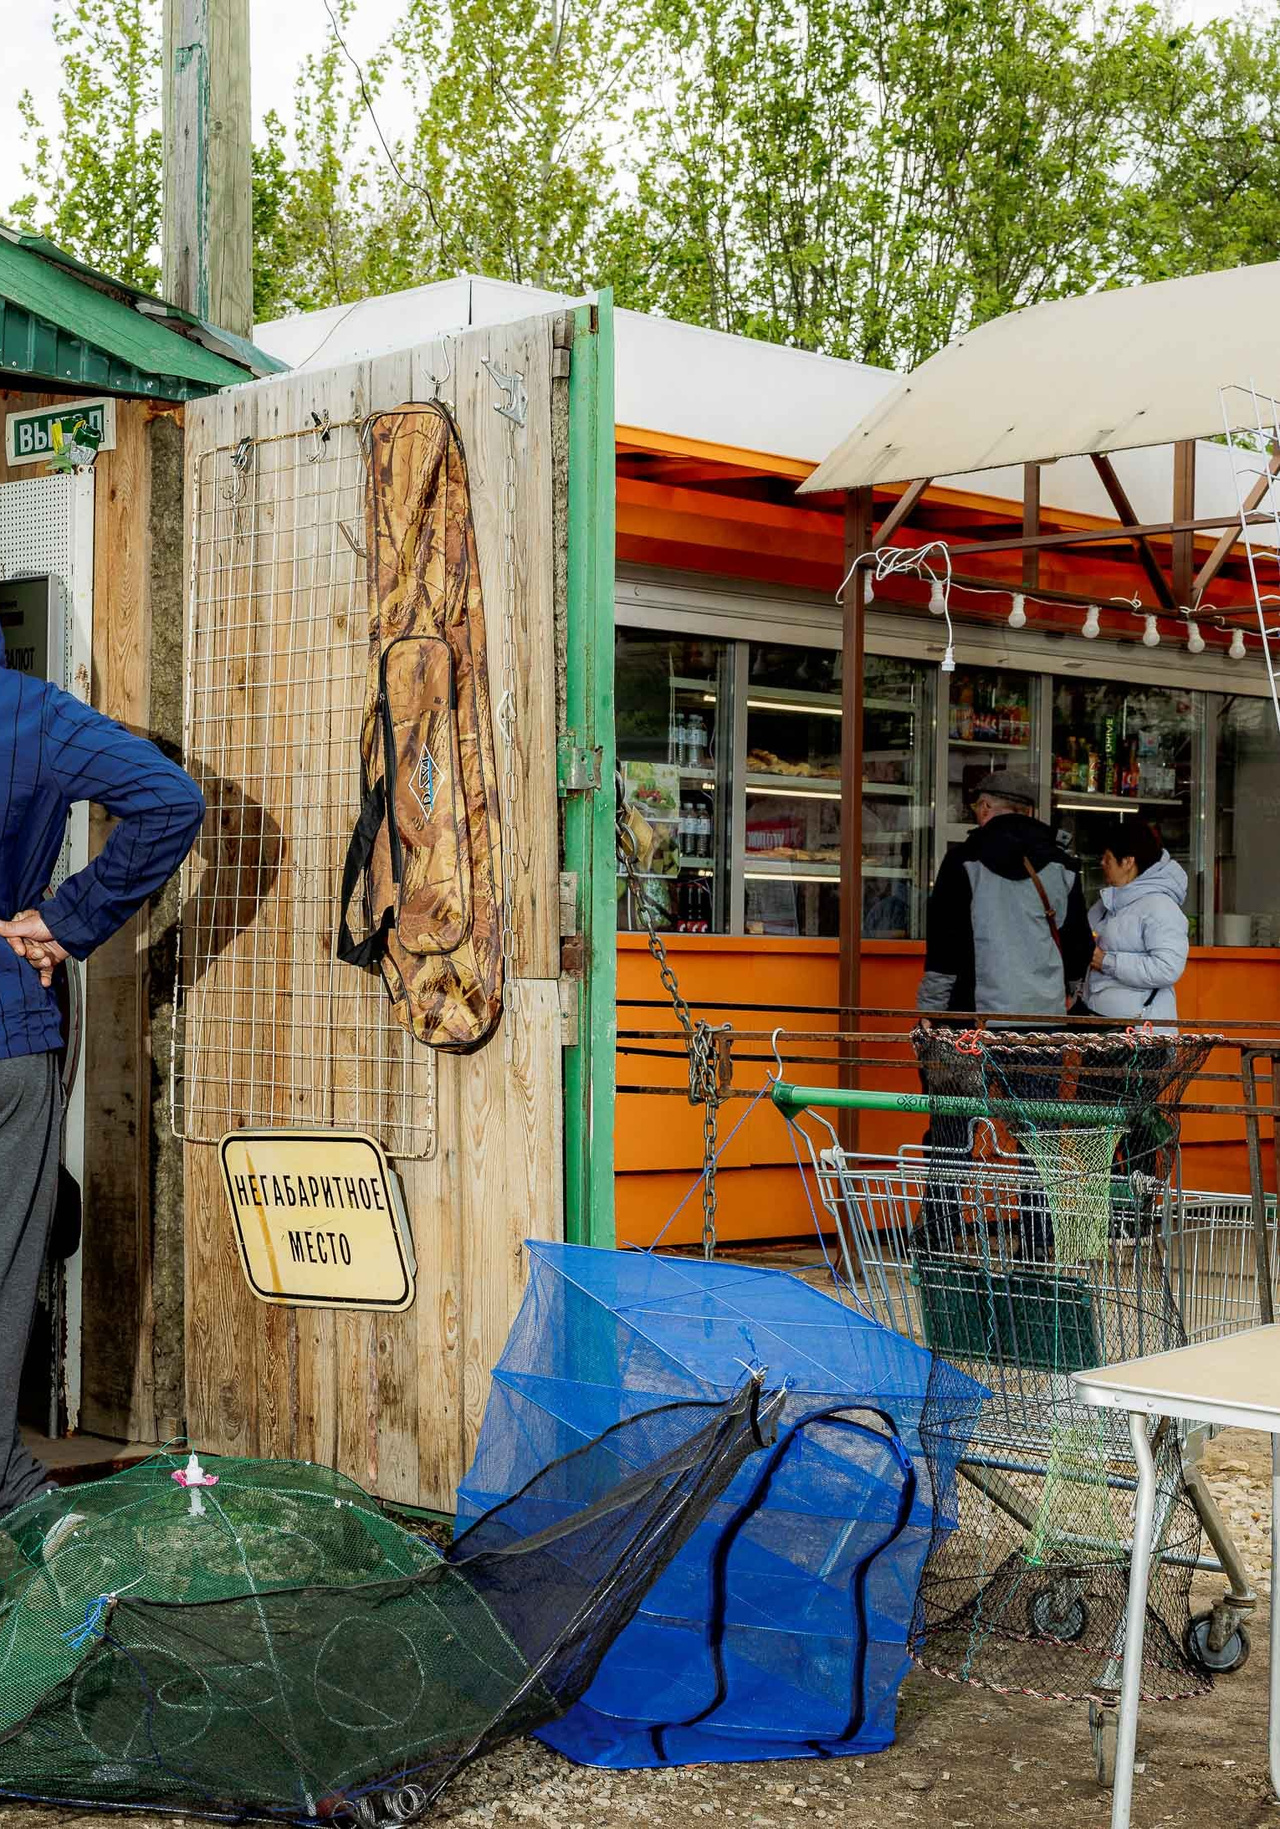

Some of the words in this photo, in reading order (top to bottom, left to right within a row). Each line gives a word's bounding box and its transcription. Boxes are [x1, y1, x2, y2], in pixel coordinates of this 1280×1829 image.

[19, 409, 104, 453] ВЫД
[1105, 718, 1113, 752] DRIVE
[233, 1174, 385, 1211] НЕГАБАРИТНОЕ
[287, 1230, 352, 1266] МЕСТО
